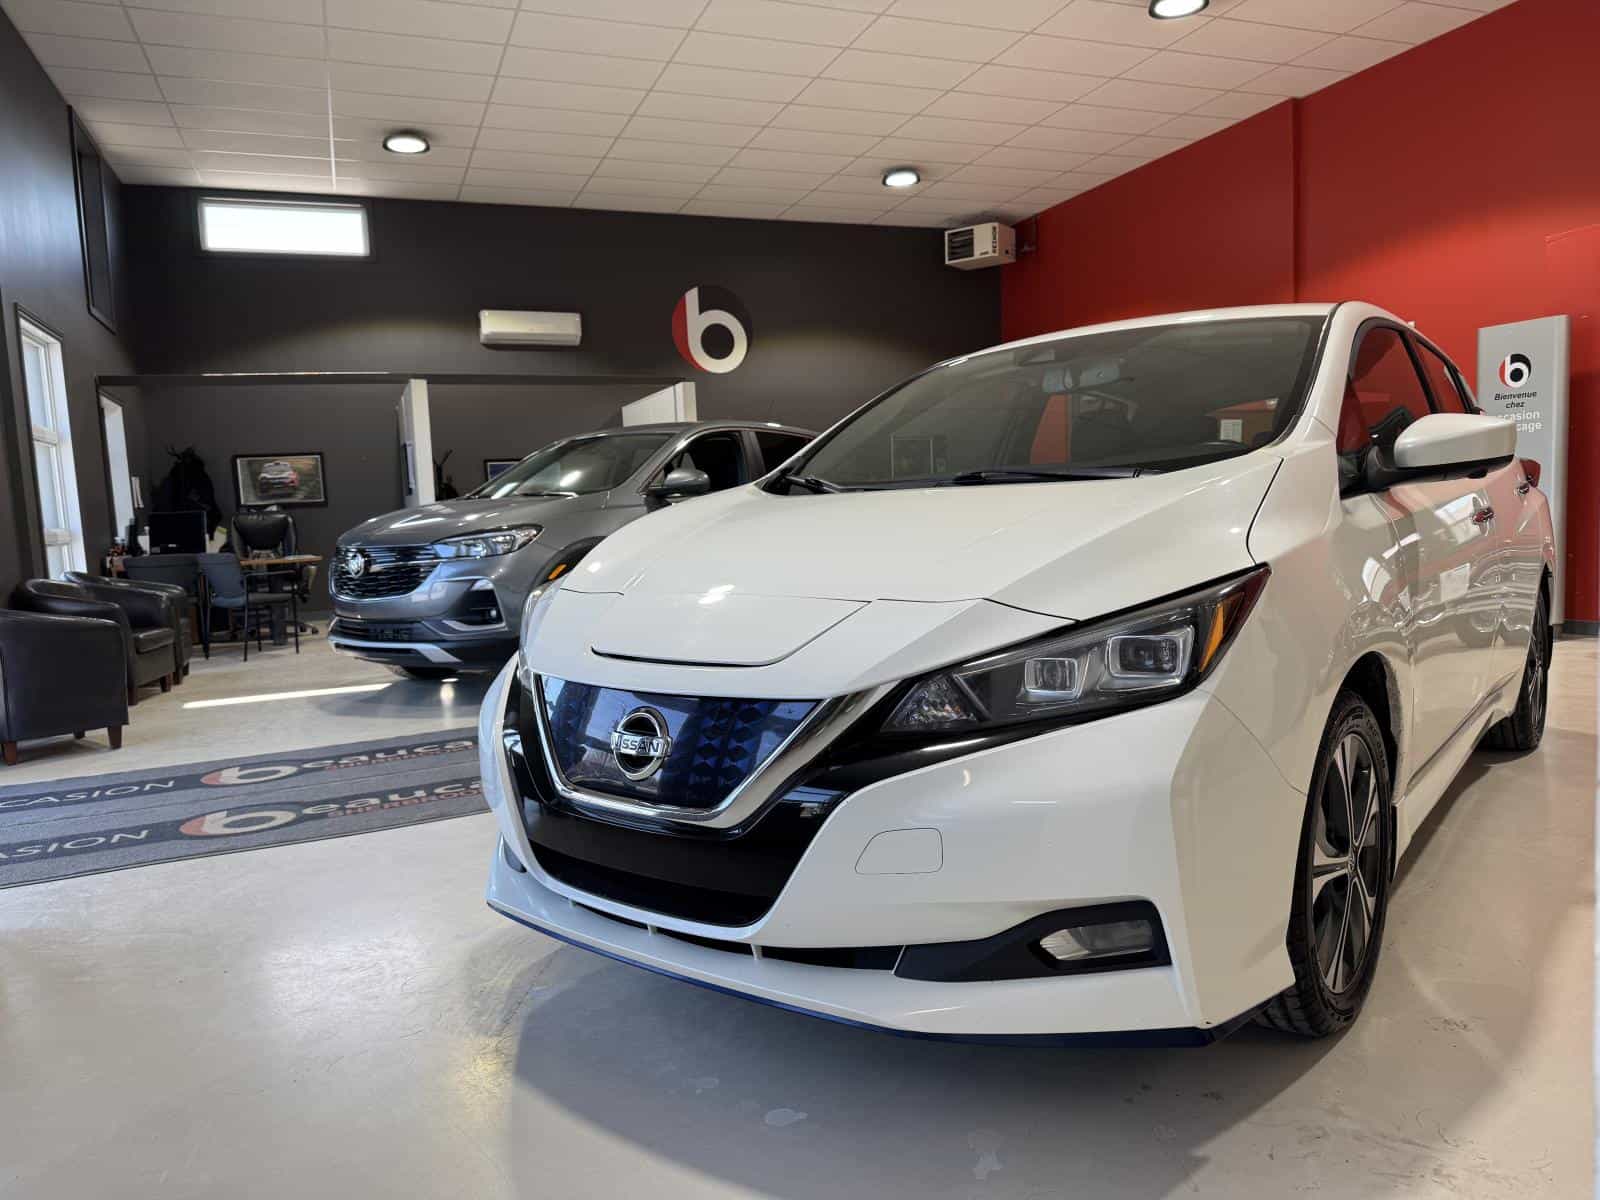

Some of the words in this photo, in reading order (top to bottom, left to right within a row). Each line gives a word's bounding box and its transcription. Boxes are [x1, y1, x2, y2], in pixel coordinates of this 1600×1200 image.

[1494, 391, 1537, 401] Bienvenue
[1505, 401, 1525, 409] chez
[1497, 410, 1540, 421] casion
[612, 735, 660, 753] NISSAN
[0, 829, 149, 859] SION
